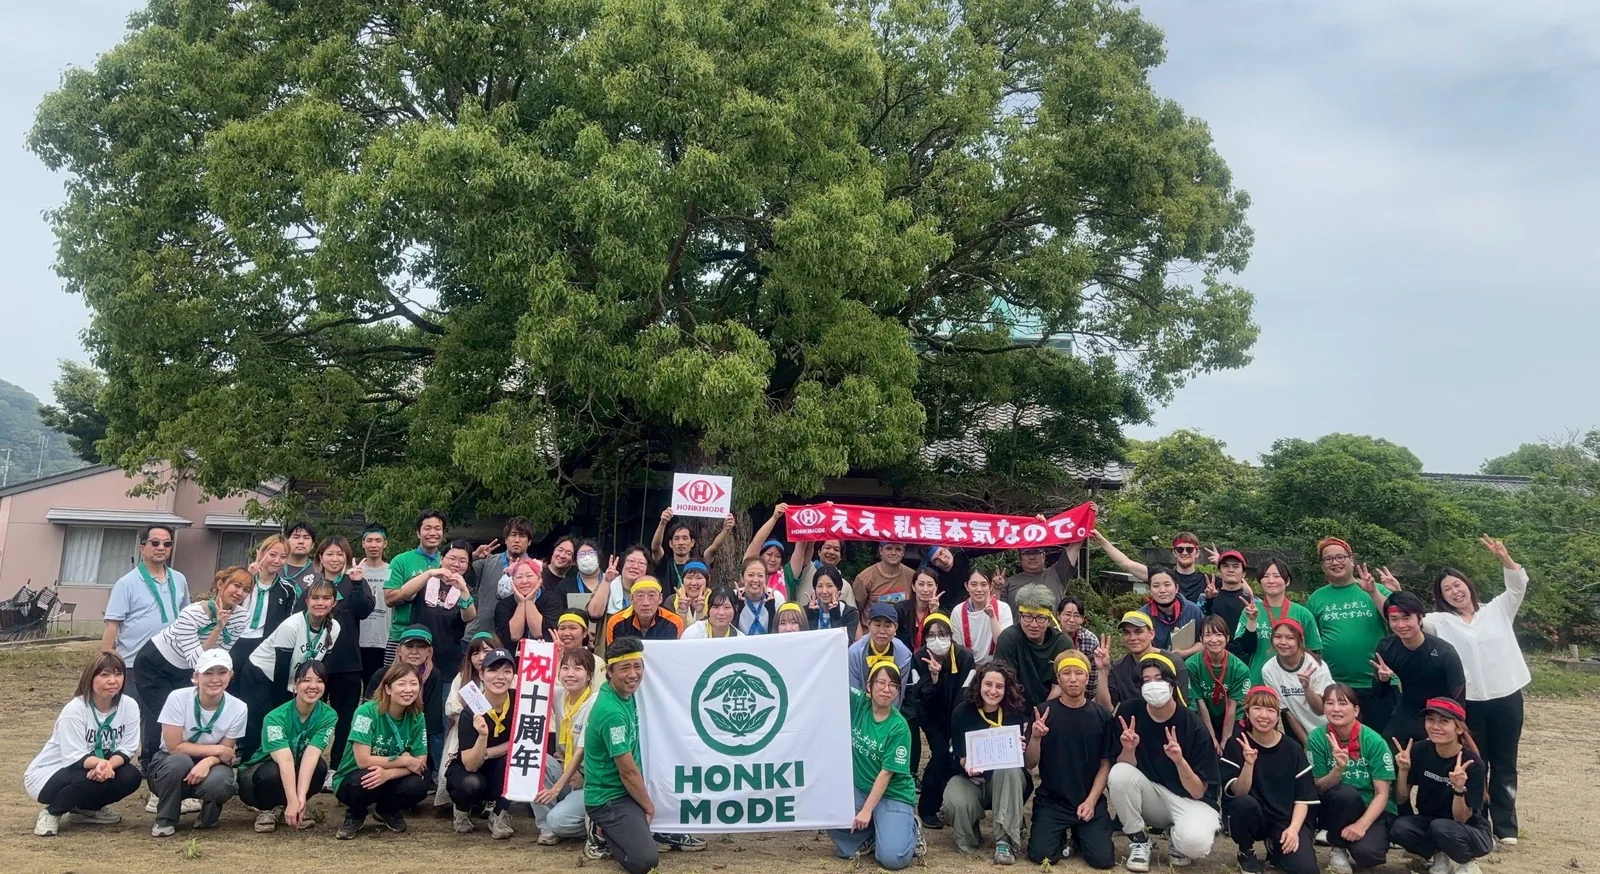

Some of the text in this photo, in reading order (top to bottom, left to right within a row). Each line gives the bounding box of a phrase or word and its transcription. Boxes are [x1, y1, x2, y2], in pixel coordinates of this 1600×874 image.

[830, 508, 1086, 545] ええ、私達本気なので。
[1323, 609, 1373, 622] 本気ですから
[509, 652, 554, 777] 祝十周年
[674, 760, 805, 794] HONKI
[679, 795, 796, 825] MODE
